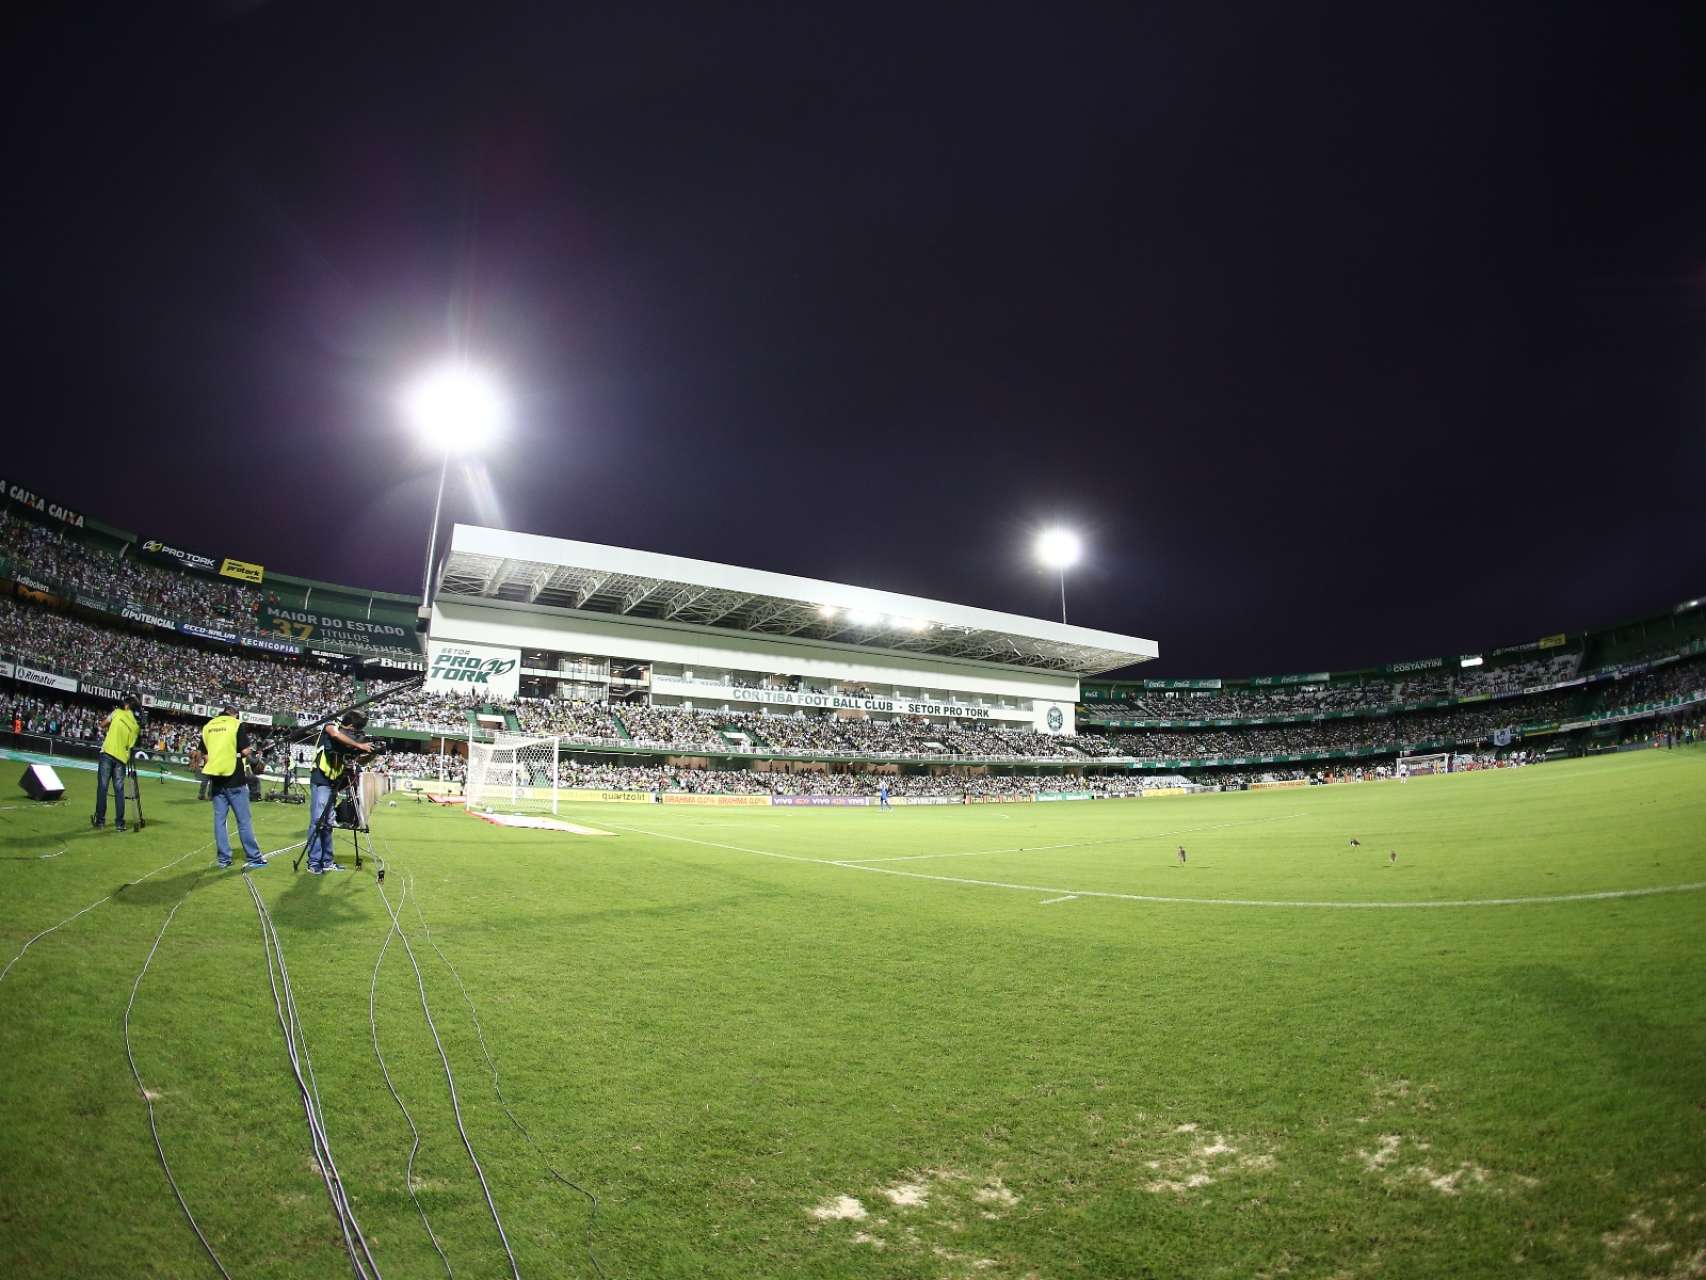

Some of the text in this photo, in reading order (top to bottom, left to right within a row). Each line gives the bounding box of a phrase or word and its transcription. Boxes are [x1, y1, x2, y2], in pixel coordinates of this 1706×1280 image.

[9, 485, 85, 528] CAIXA CAIXA
[161, 545, 184, 558] PRO
[187, 553, 216, 567] TORK
[266, 607, 405, 637] MAIOR DO ESTADO
[271, 617, 314, 641] 37
[440, 647, 471, 655] SETOR
[434, 654, 482, 669] PRO
[24, 671, 57, 686] Rimatur
[430, 666, 493, 683] TORK
[733, 688, 793, 705] CORITIBA
[798, 692, 830, 707] FOOT
[833, 696, 861, 709] BALL
[864, 699, 893, 711] CLUB
[908, 703, 941, 715] SETOR
[943, 705, 963, 716] PRO
[965, 707, 990, 718] TORK
[602, 792, 645, 801] quartzolit
